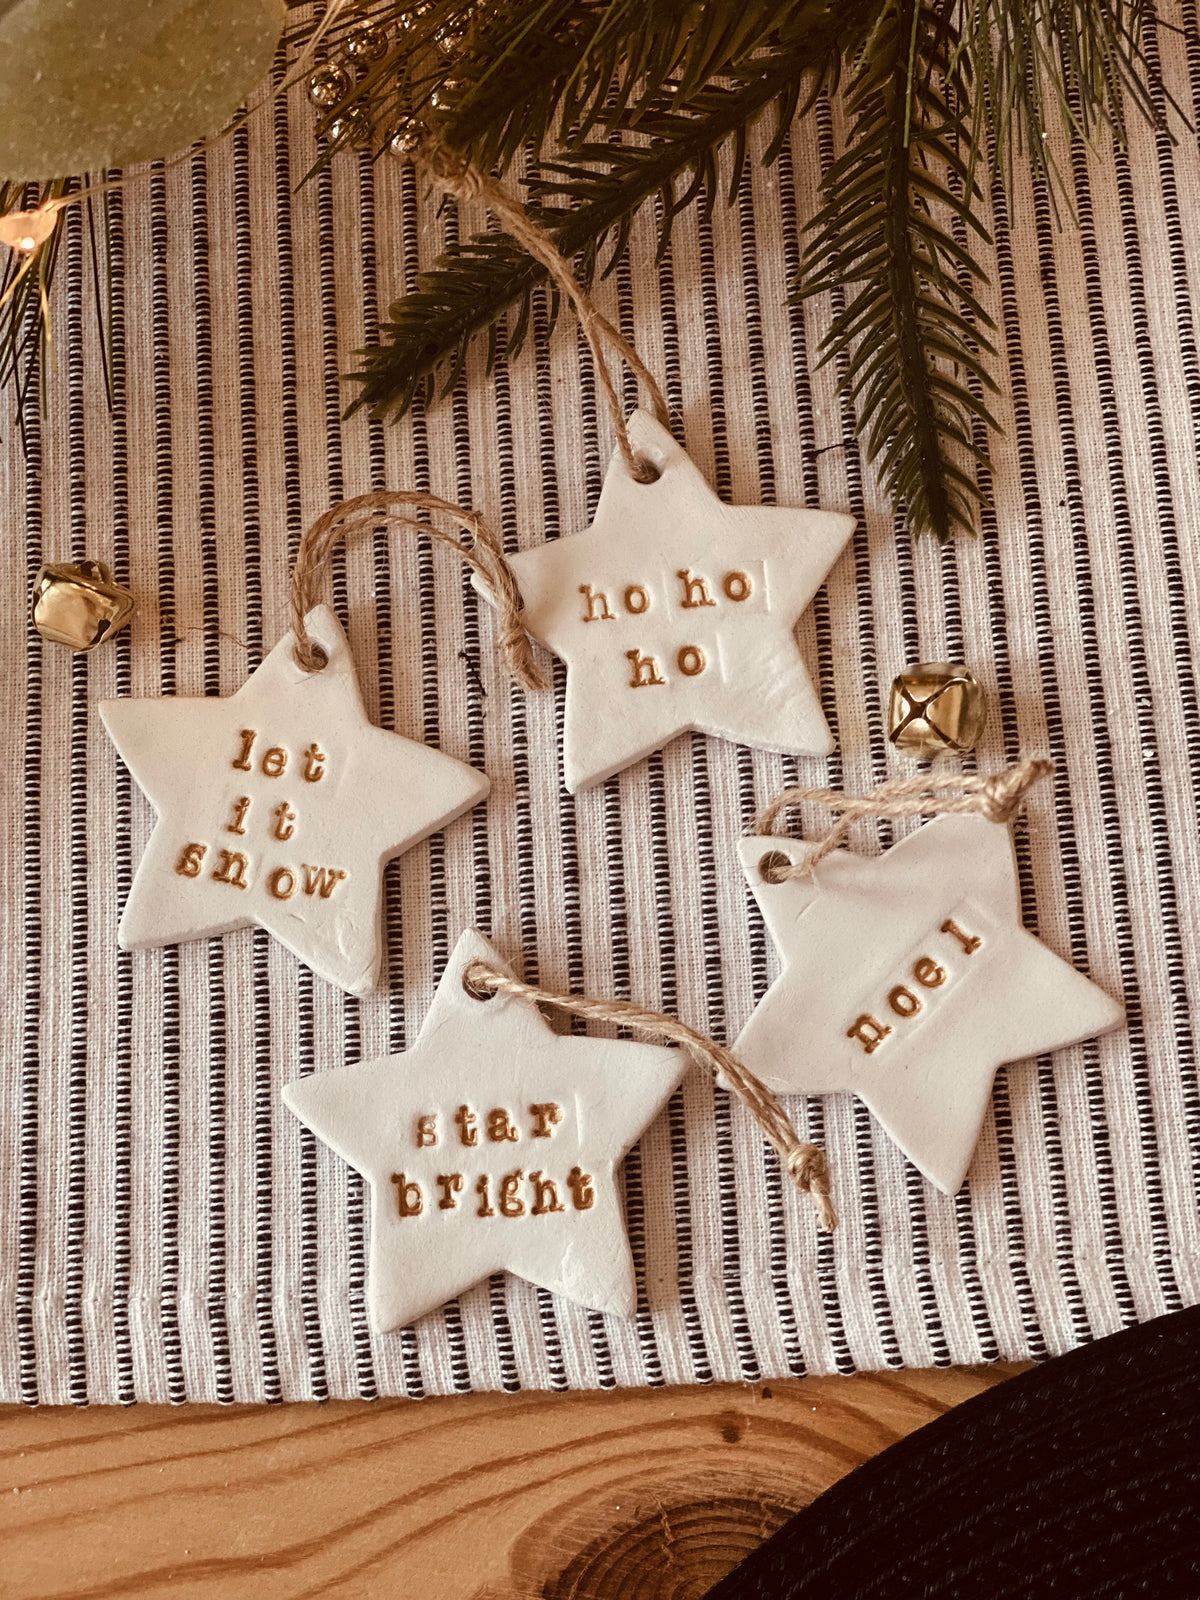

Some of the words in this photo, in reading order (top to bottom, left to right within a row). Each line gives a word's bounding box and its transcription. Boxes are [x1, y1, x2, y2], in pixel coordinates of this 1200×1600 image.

[578, 583, 650, 623] ho
[676, 569, 752, 609] ho
[624, 645, 707, 688] ho
[232, 728, 326, 783] let
[227, 796, 296, 841] it
[175, 843, 347, 900] snow
[846, 918, 983, 1054] noel
[416, 1102, 564, 1148] star
[391, 1166, 595, 1218] bright
